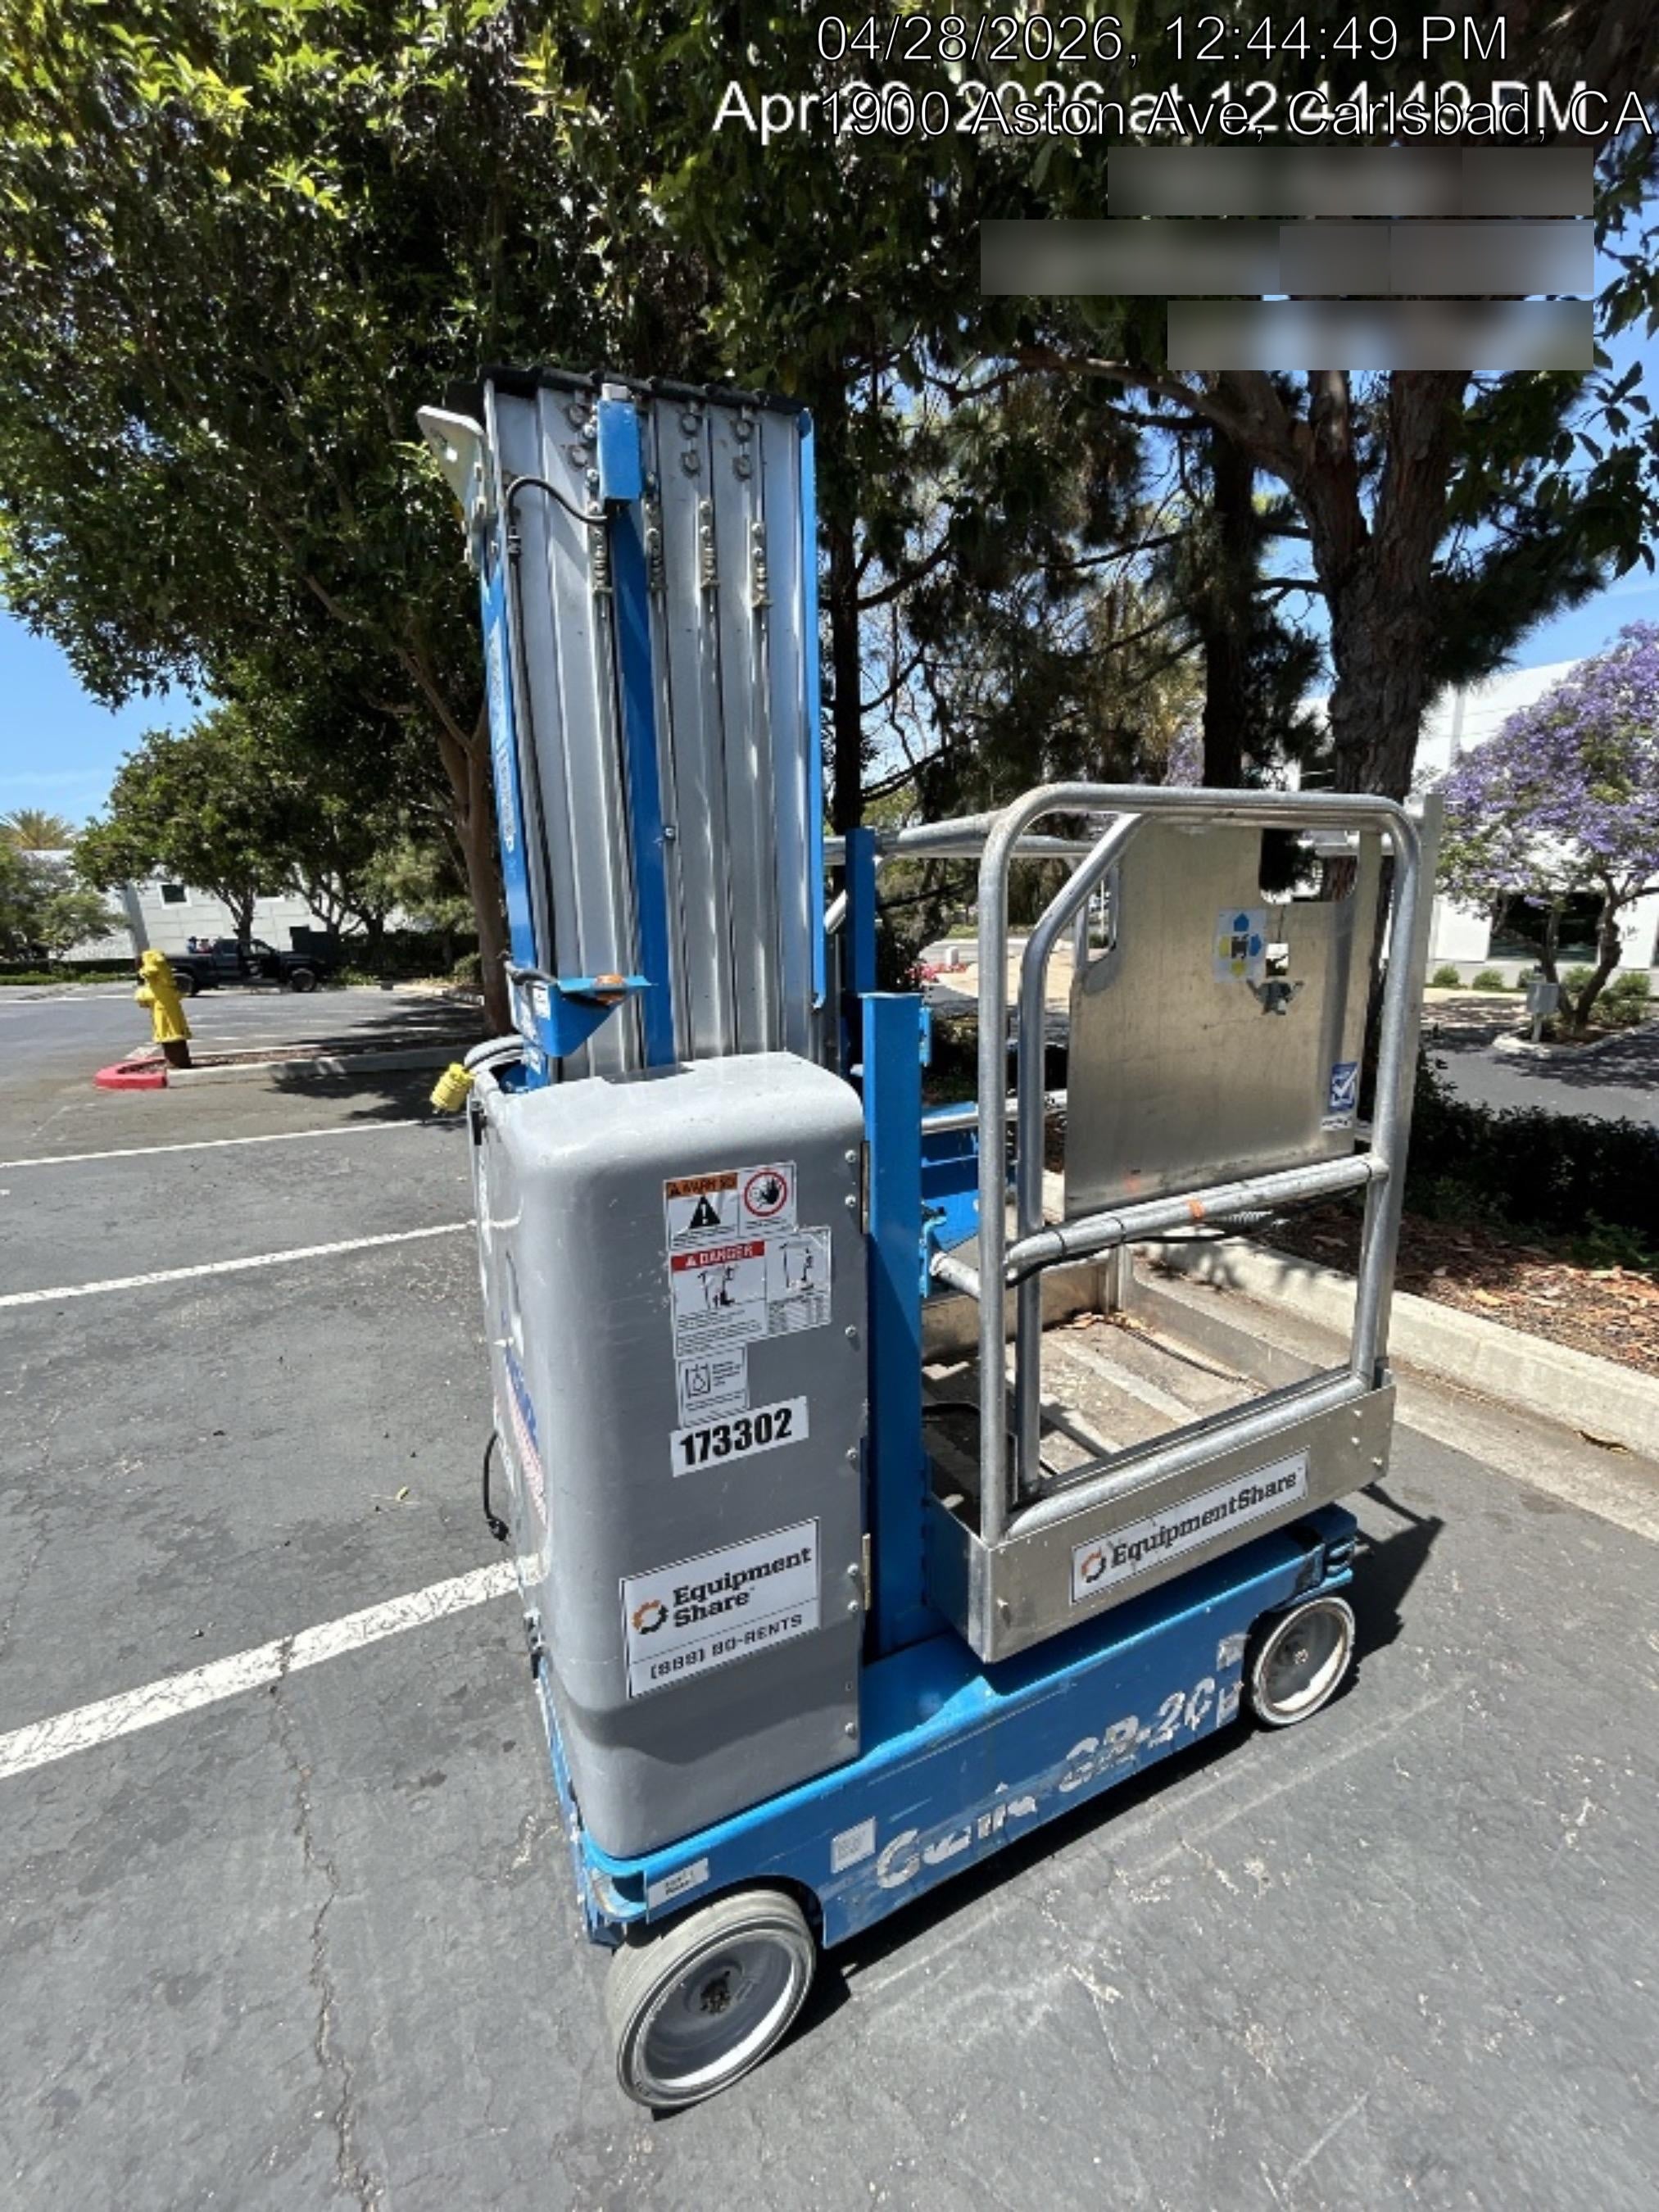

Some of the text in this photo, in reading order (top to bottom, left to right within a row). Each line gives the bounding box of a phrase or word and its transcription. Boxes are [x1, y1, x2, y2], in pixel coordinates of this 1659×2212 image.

[700, 1244, 752, 1264] DANGER
[680, 1407, 793, 1466] 173302
[1110, 1472, 1297, 1569] EquipmentShare
[673, 1547, 812, 1608] Equipment
[673, 1592, 750, 1628] Share
